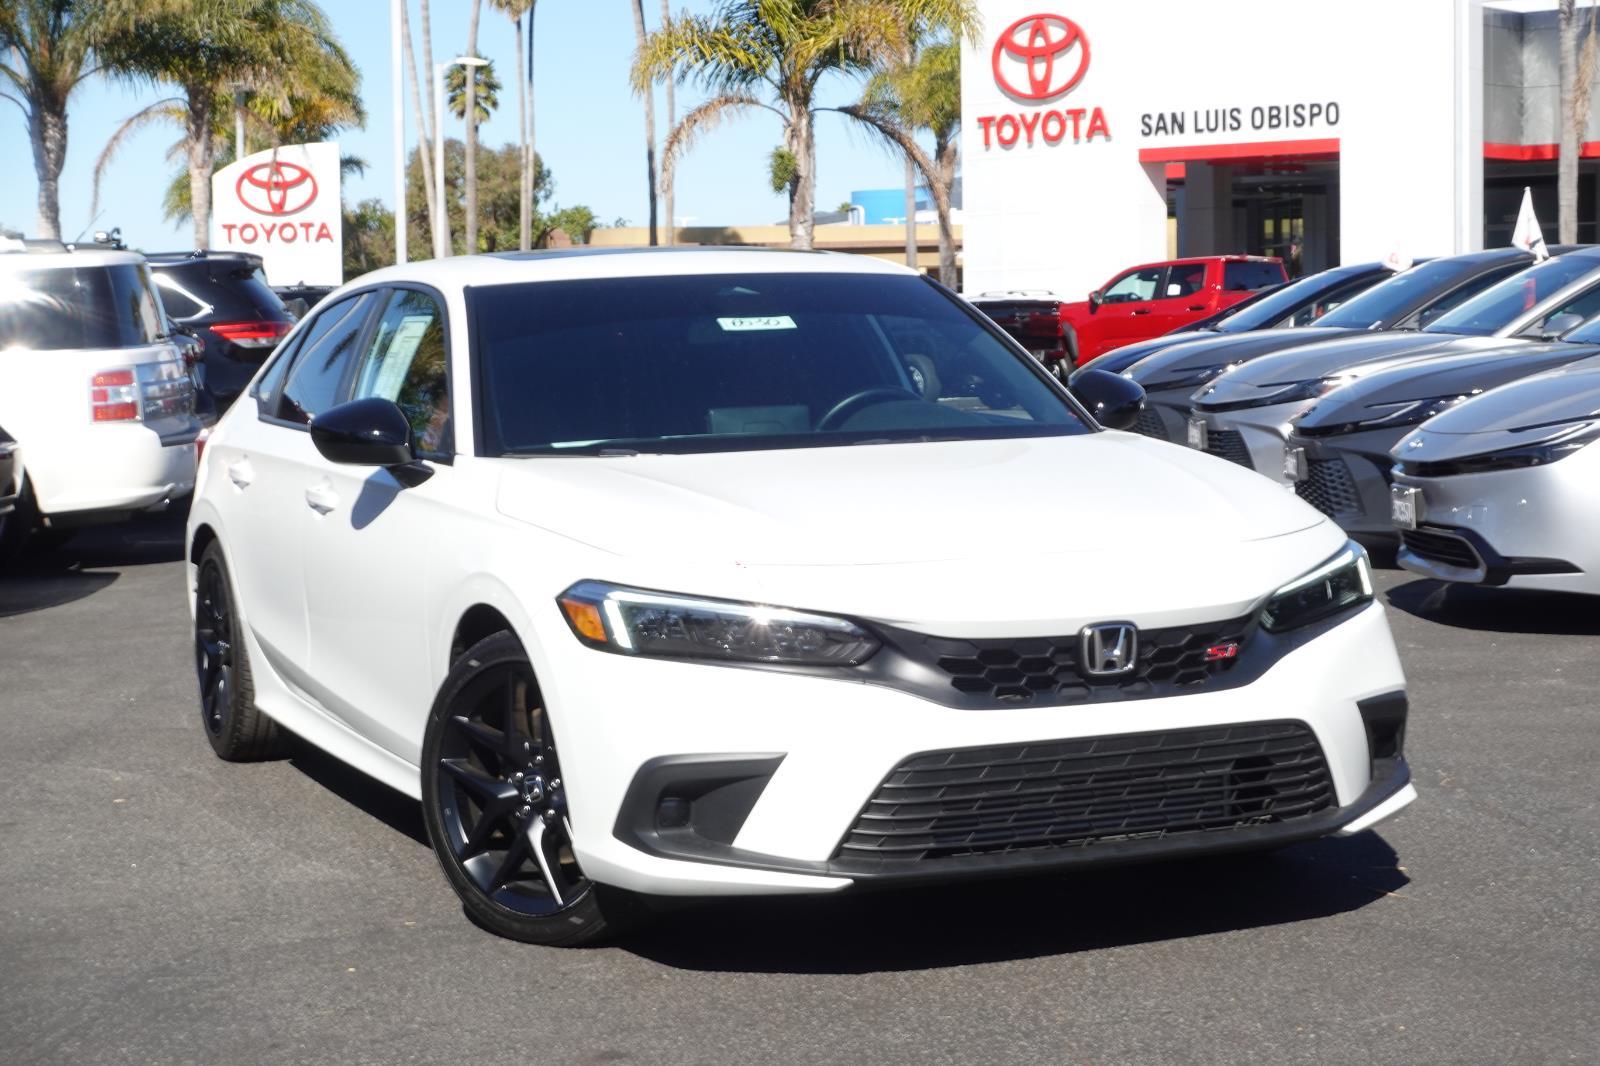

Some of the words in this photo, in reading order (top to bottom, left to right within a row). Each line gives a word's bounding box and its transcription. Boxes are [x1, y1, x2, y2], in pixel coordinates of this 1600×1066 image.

[976, 106, 1111, 150] TOYOTA
[1141, 111, 1185, 137] SAN
[1194, 107, 1242, 134] LUIS
[1251, 101, 1340, 130] OBISPO
[221, 222, 333, 244] TOYOTA
